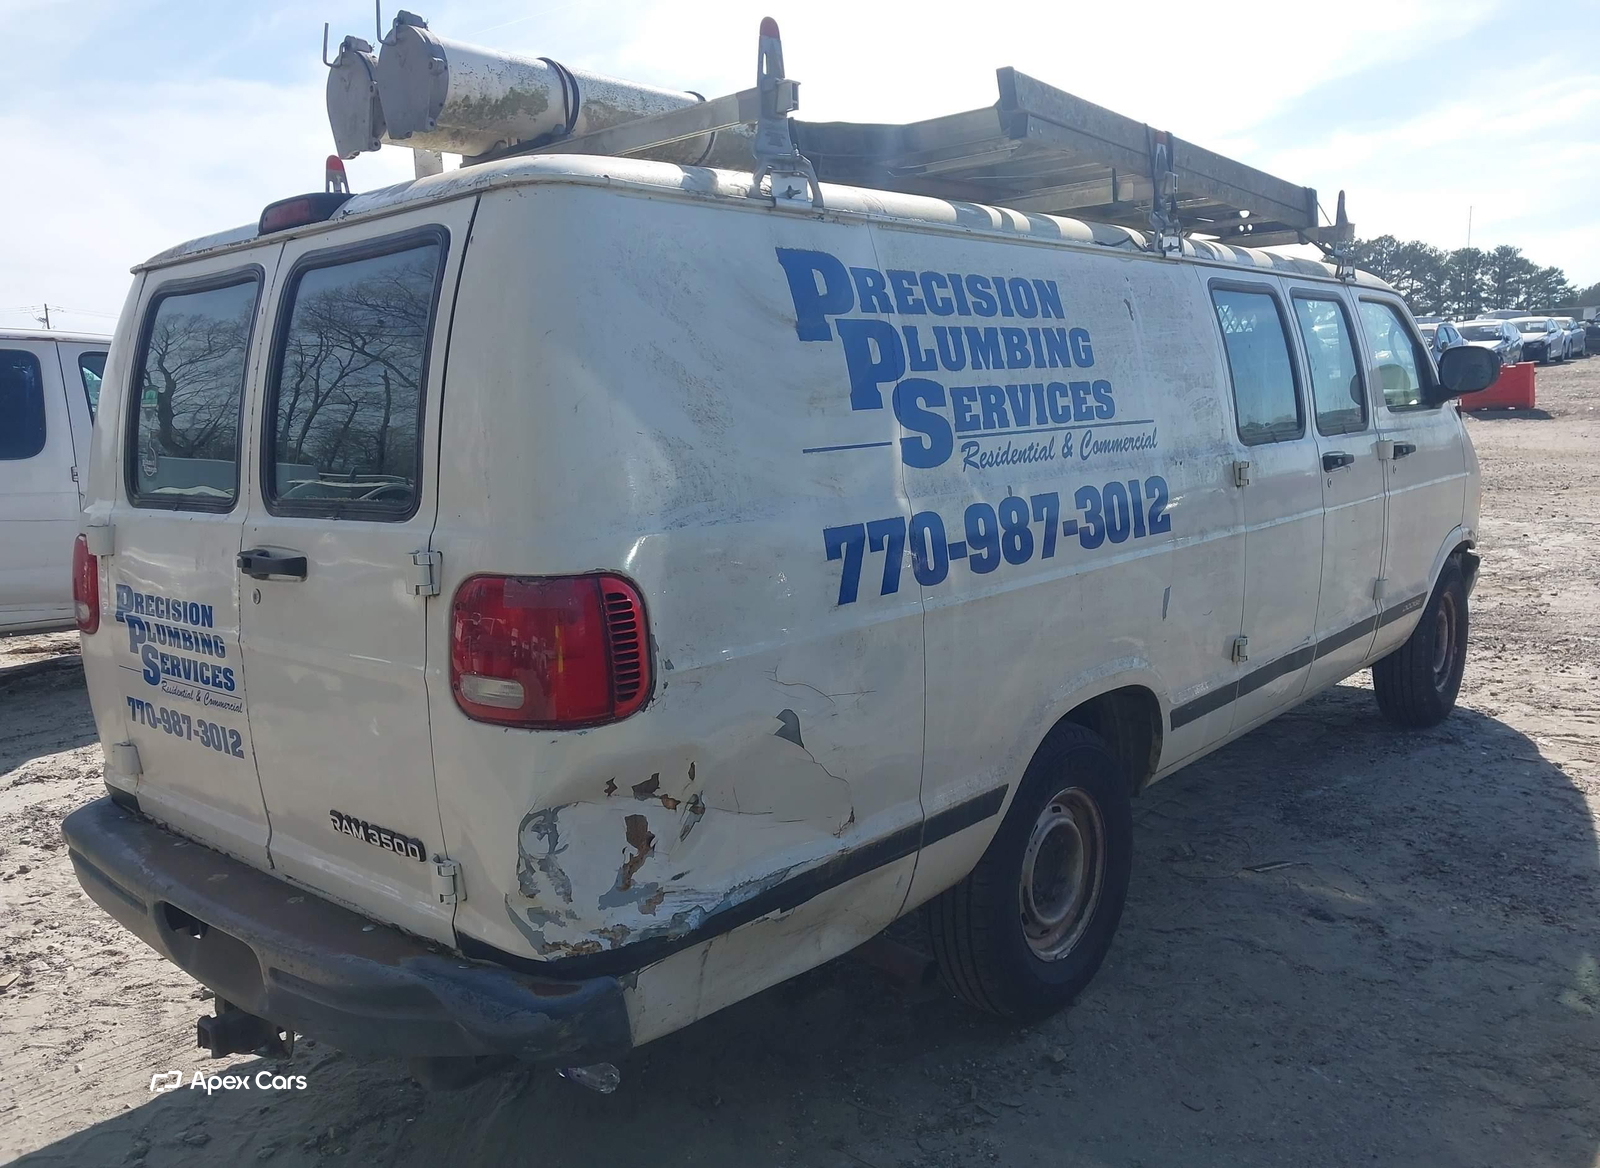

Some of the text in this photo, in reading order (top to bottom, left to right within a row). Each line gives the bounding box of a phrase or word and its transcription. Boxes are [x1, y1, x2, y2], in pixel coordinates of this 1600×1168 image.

[775, 247, 1065, 341] PRECISION
[835, 319, 1095, 411] PLUMBING
[892, 378, 1116, 468] SERVICES
[960, 427, 1158, 472] Residential & Commercial
[822, 476, 1172, 606] 770-987-3012
[115, 584, 213, 628] PRECISION
[125, 615, 226, 659] PLUMBING
[141, 644, 235, 691] SERVICES
[161, 680, 243, 713] Residential & Commercial
[127, 696, 245, 759] 770-987-3012
[329, 812, 422, 862] RAM 3500
